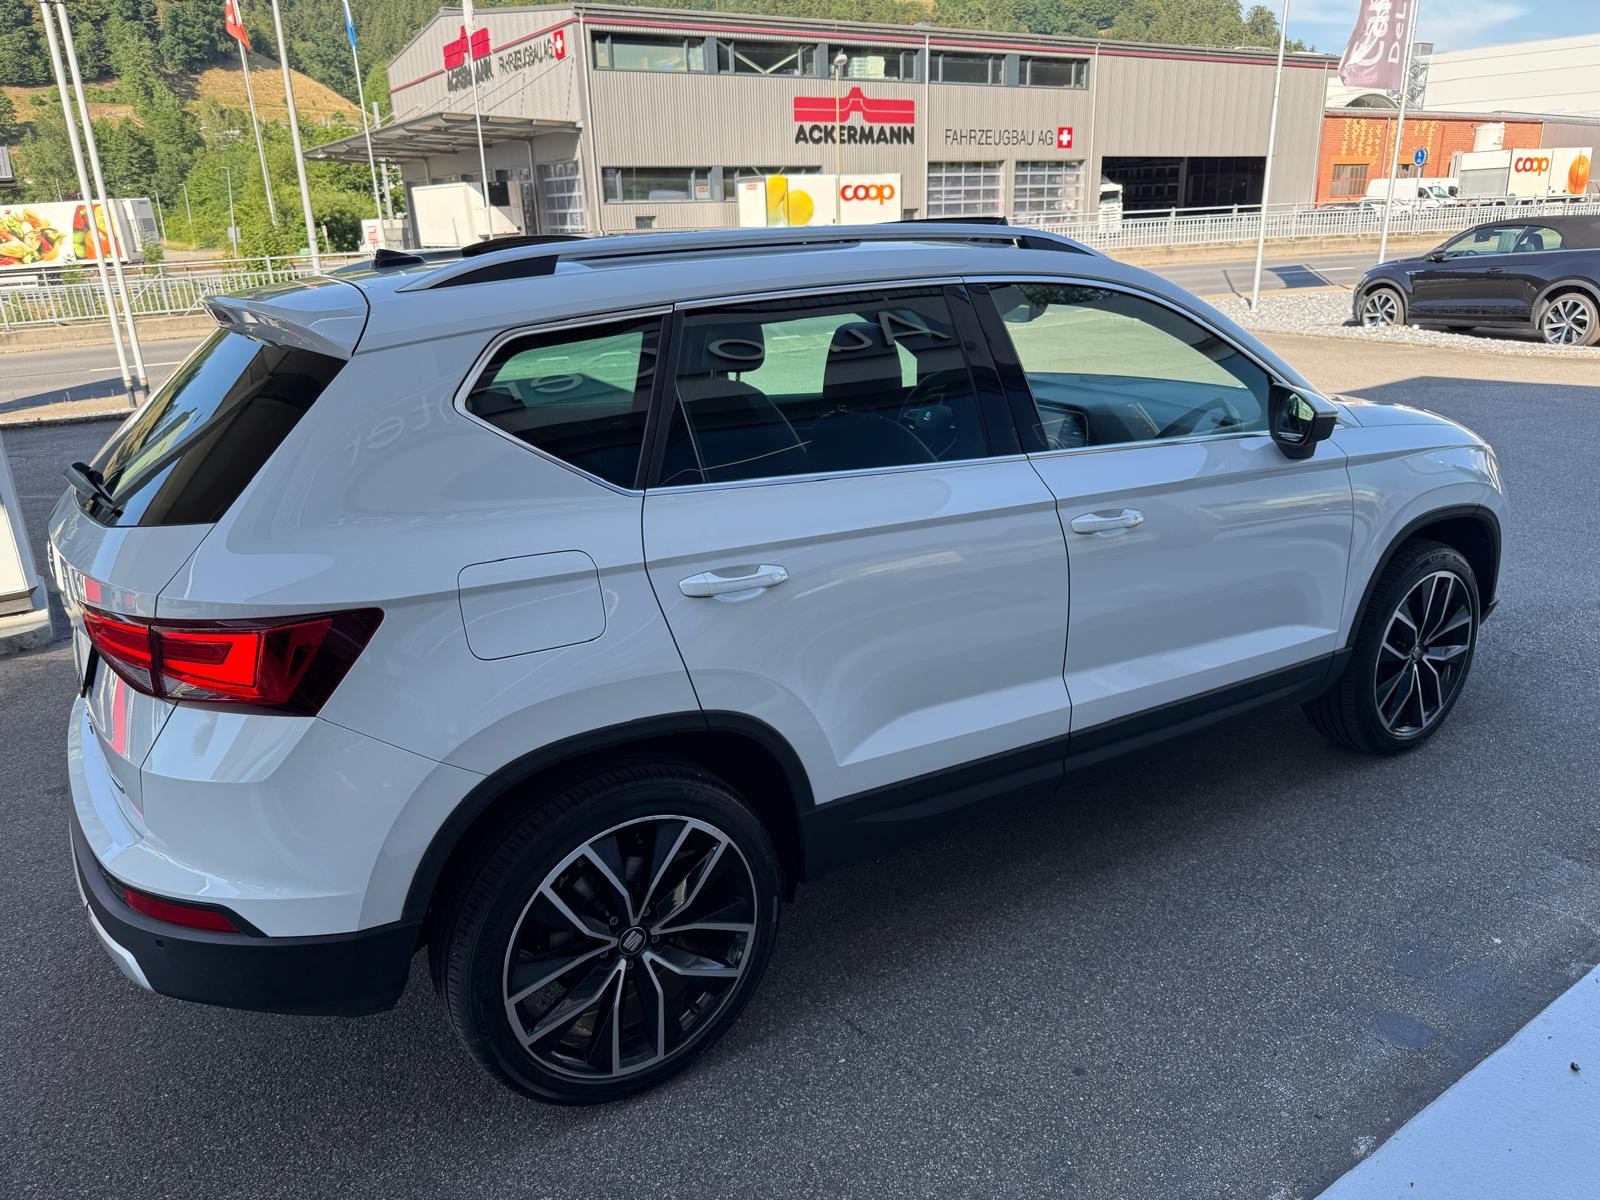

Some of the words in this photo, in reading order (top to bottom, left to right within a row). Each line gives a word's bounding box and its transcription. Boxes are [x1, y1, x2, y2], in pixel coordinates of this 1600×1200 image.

[795, 124, 915, 145] ACKERMANN
[944, 129, 1035, 146] FAHRZEUGBAU
[1038, 130, 1054, 146] AG
[1515, 157, 1549, 176] coop
[840, 183, 895, 205] coop
